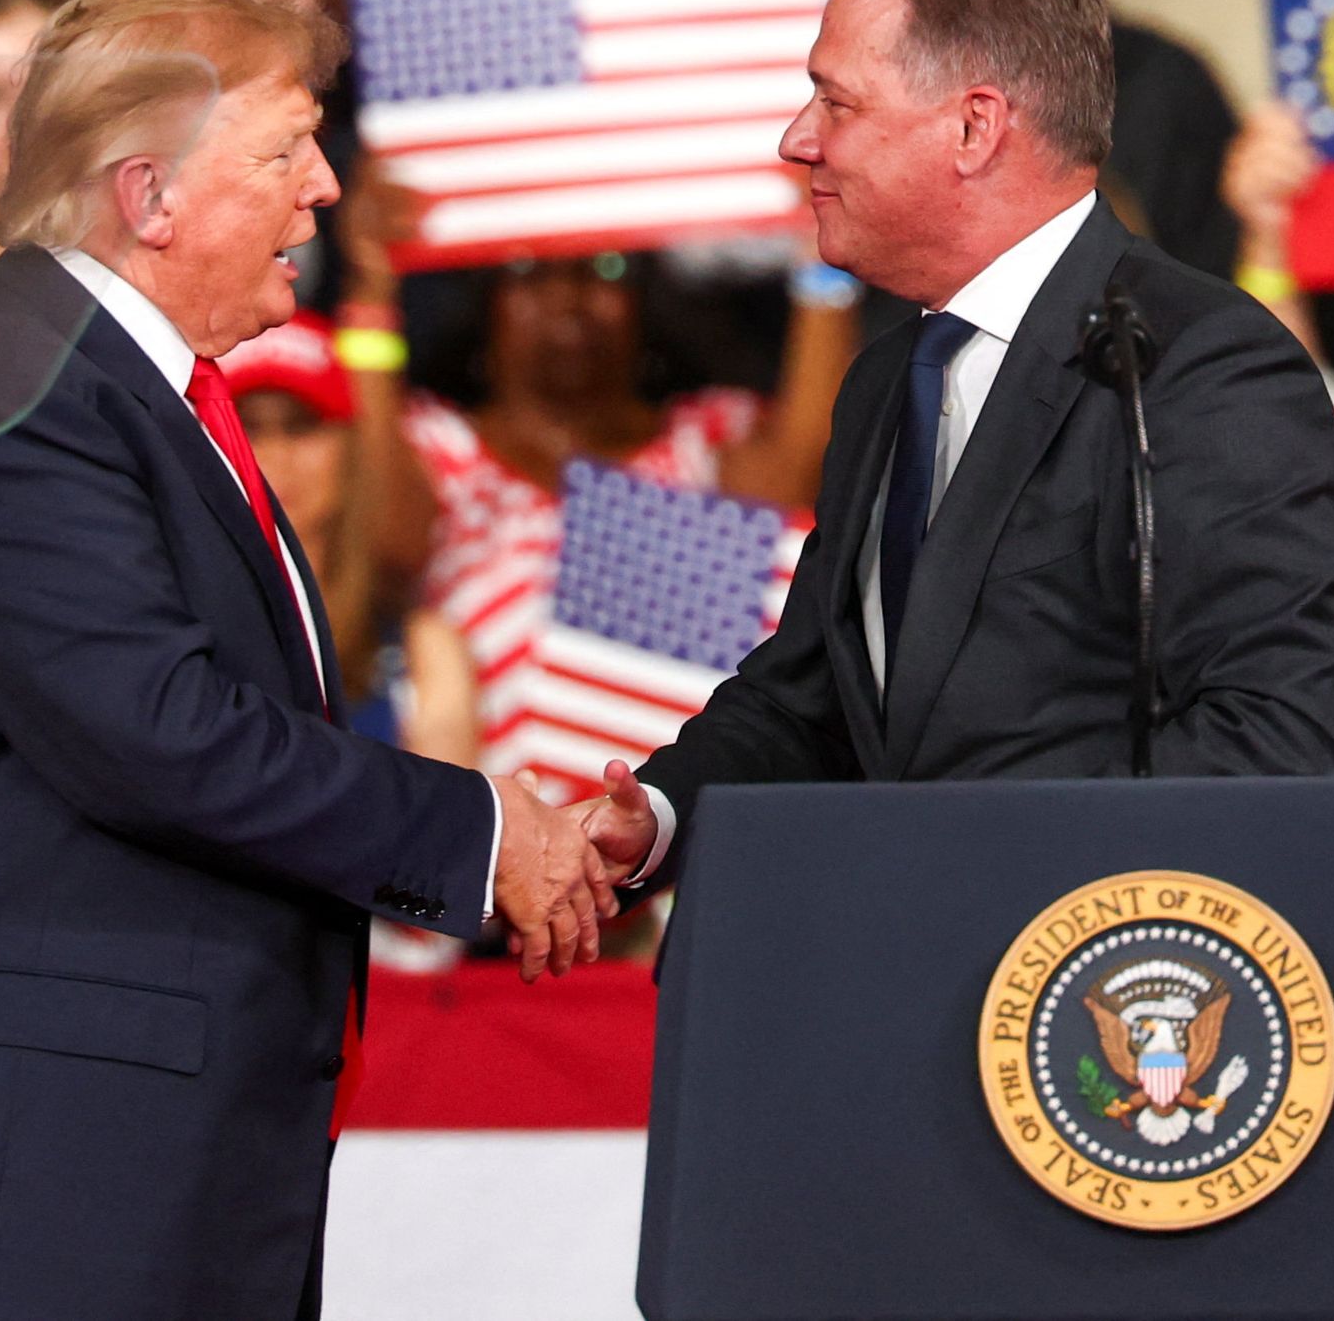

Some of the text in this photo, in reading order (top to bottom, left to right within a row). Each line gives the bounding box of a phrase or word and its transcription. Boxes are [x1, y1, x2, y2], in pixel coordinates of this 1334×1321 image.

[993, 885, 1327, 1211] SEAL OF THE PRESIDENT OF THE UNITED STATES
